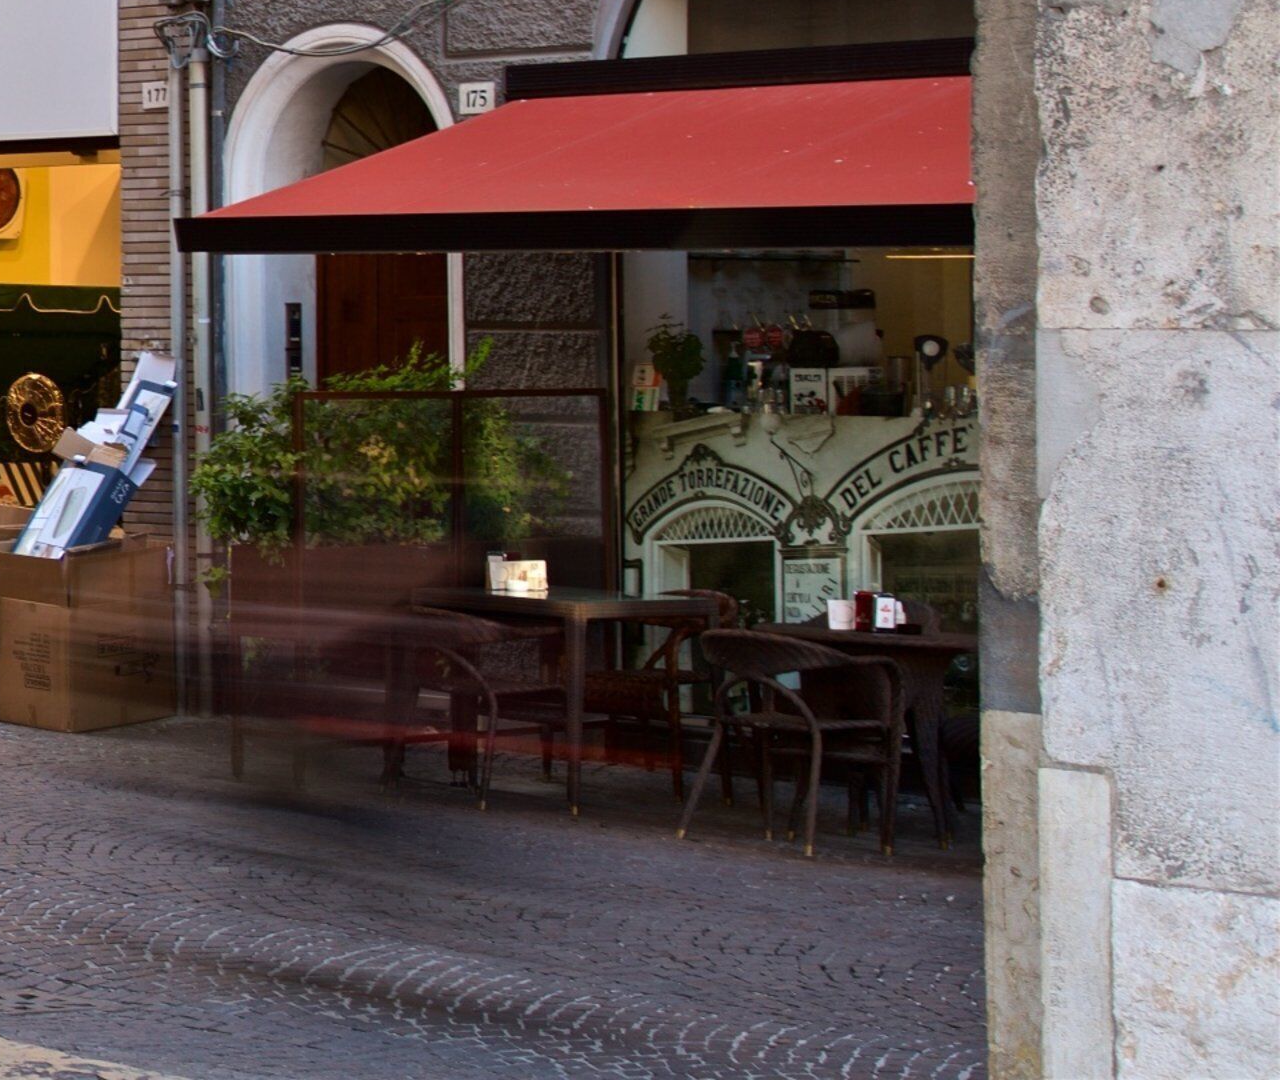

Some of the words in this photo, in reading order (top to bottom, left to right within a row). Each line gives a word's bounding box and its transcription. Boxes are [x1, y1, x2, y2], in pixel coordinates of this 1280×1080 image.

[147, 87, 168, 104] 177
[465, 89, 488, 108] 175
[633, 480, 677, 528] GRANDE
[679, 467, 786, 521] TORREFAZIONE
[840, 469, 882, 510] DEL
